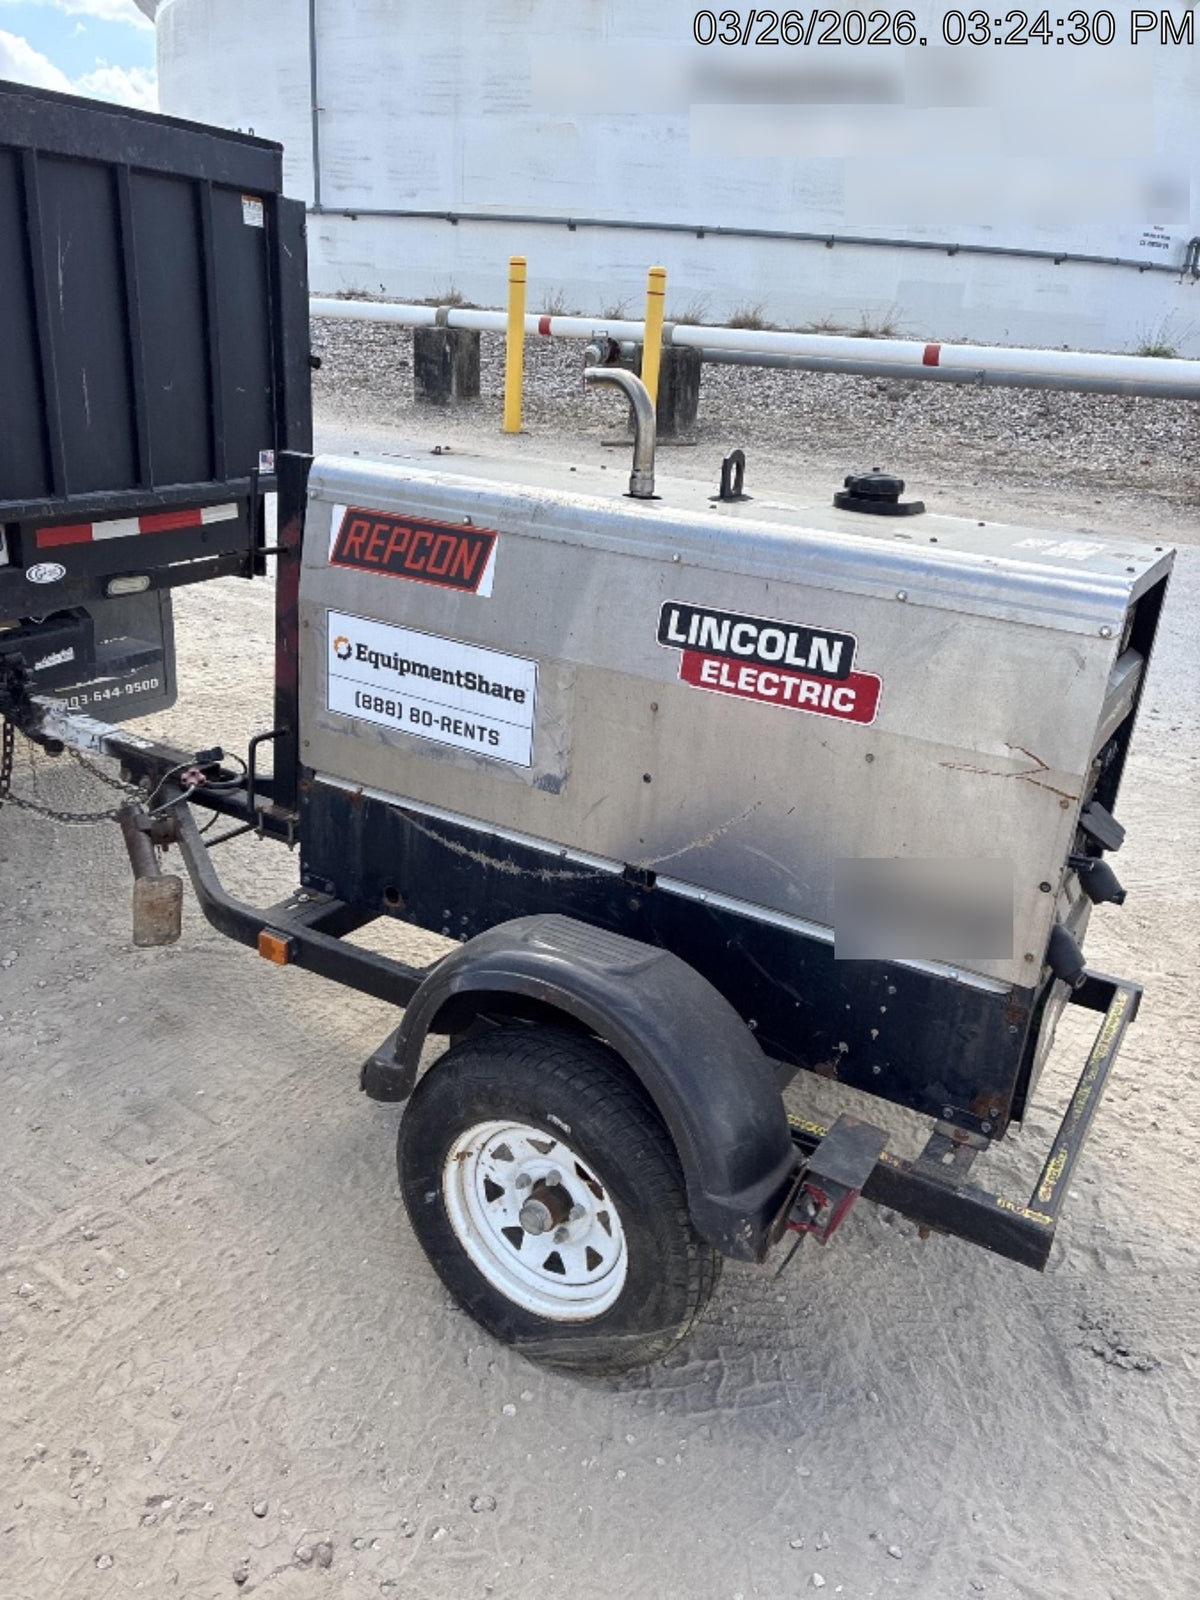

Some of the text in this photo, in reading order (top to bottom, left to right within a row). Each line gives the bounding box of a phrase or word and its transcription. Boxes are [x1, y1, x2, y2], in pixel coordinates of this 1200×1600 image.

[342, 519, 483, 581] REPCON
[667, 609, 844, 674] LINCOLN
[355, 642, 526, 704] EquipmentShare
[700, 658, 856, 712] ELECTRIC
[355, 691, 500, 746] (888) 80-RENTS
